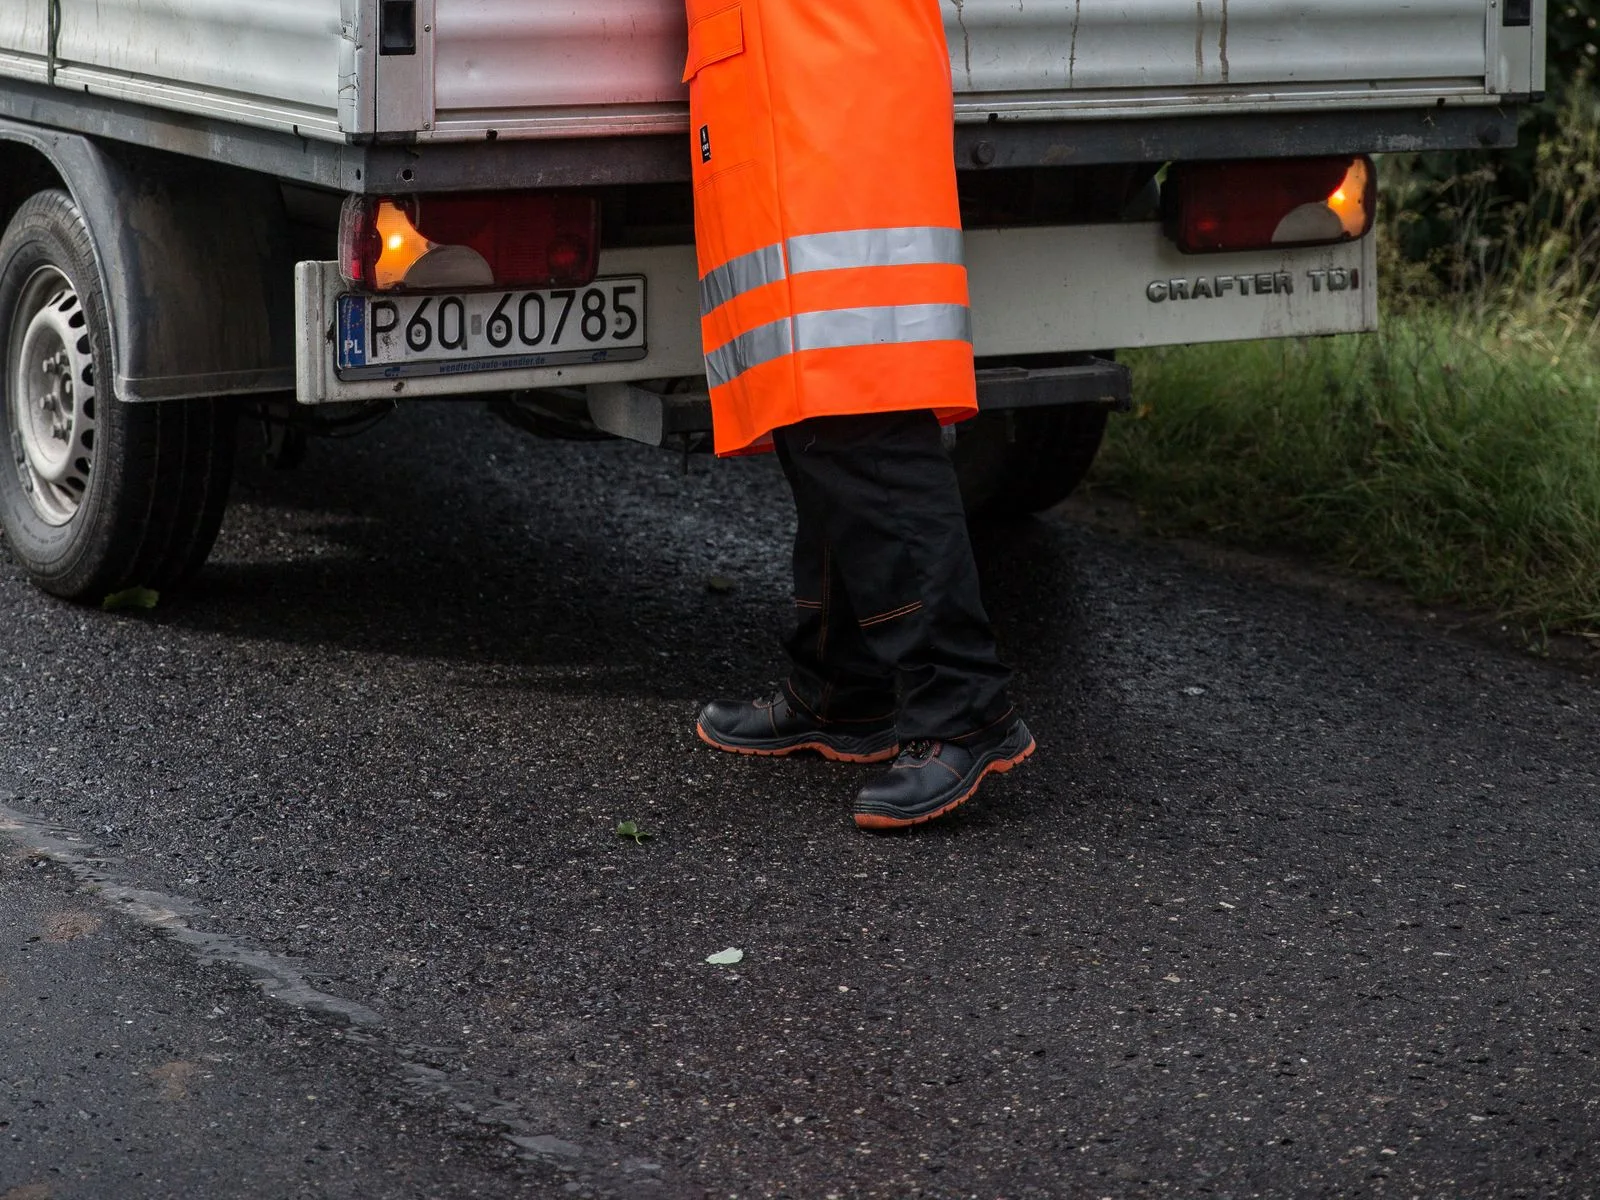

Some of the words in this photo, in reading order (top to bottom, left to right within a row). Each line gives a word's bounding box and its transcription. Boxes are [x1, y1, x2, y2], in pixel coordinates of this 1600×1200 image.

[1146, 271, 1294, 303] CRAFTER
[1306, 268, 1359, 293] TDI
[486, 286, 637, 348] 60785
[344, 339, 362, 354] PL
